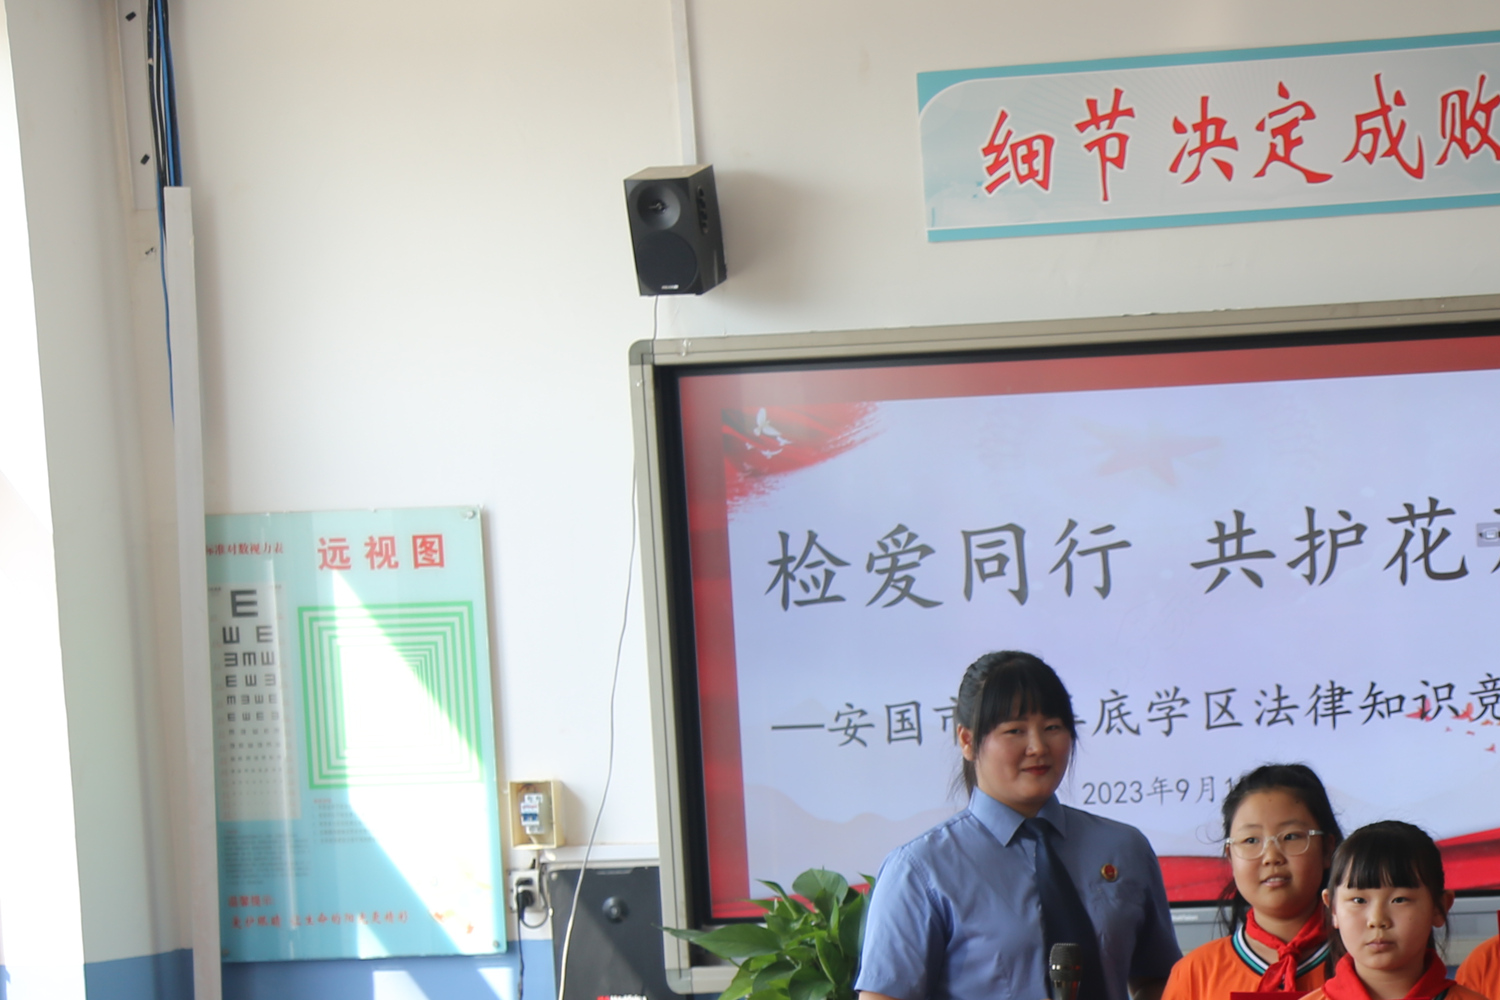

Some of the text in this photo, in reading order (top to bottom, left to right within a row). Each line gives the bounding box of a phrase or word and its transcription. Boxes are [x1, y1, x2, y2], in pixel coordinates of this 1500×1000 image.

[317, 534, 445, 570] 远视图
[764, 517, 1133, 613] 检爱同行
